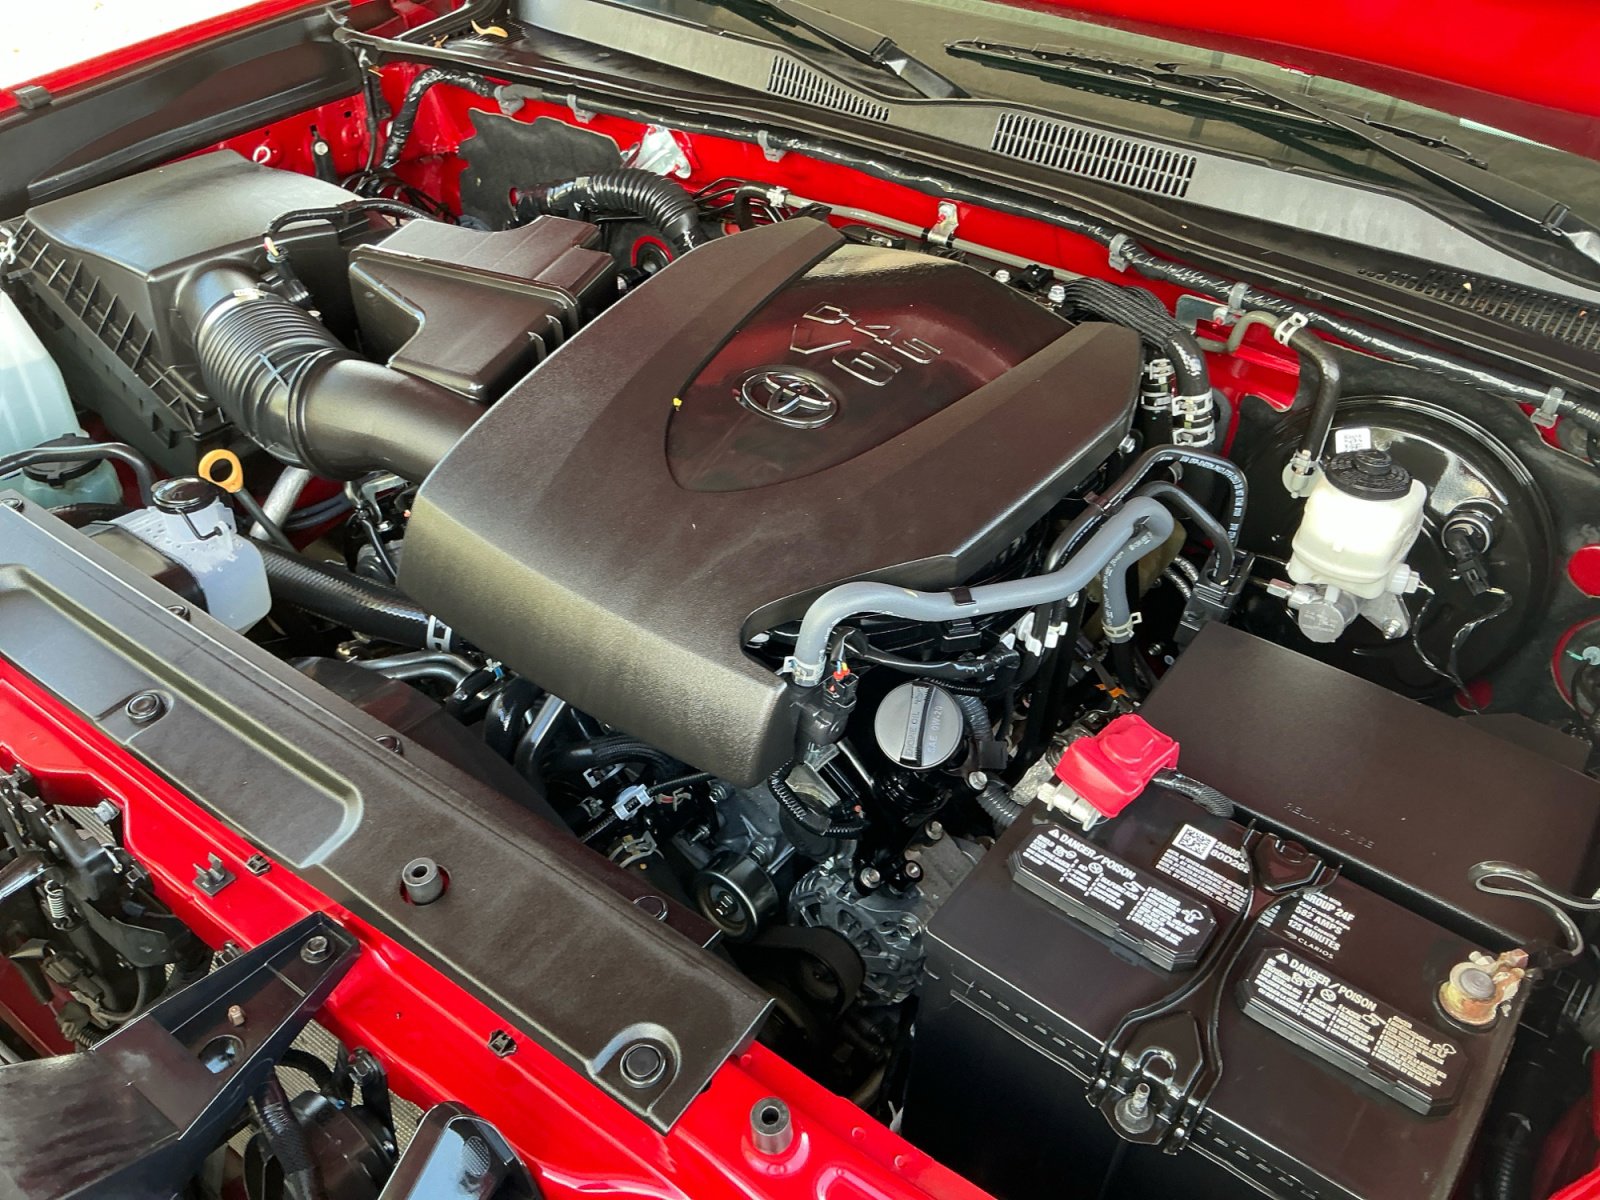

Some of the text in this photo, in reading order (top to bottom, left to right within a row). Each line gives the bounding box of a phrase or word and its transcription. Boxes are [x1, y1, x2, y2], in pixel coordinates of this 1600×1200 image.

[911, 711, 920, 726] OIL
[927, 735, 938, 753] SAE
[1294, 905, 1314, 920] 582
[1313, 916, 1343, 935] AMPS
[1303, 894, 1356, 922] GROUP 24F
[1288, 919, 1341, 951] 125 MINUTES
[1297, 937, 1334, 959] CLARIOS
